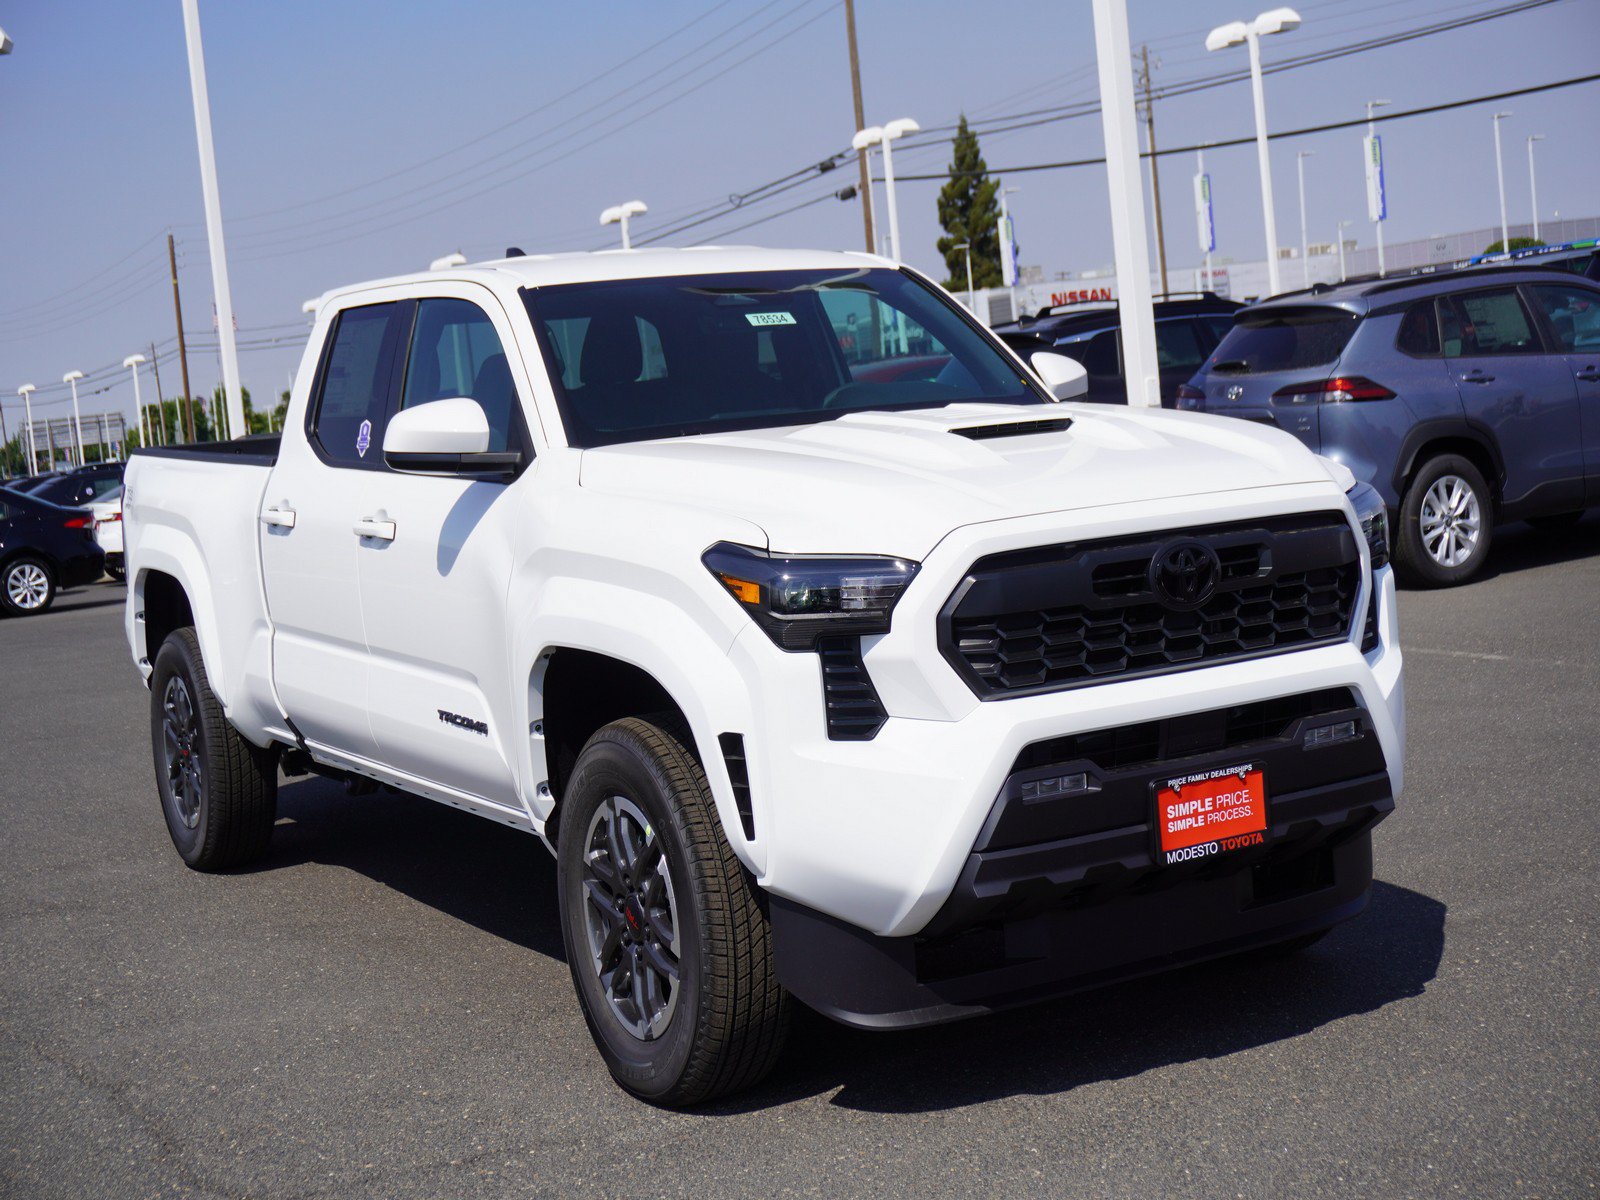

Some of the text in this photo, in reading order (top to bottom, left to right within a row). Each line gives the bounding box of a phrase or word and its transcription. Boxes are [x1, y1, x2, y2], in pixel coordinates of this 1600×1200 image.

[1051, 287, 1112, 307] NISSAN
[752, 314, 788, 324] 78534
[437, 709, 488, 737] TACOMA
[1167, 764, 1252, 788] PRICE FAMILY DEALERSHIPS
[1167, 790, 1253, 819] SIMPLE PRICE.
[1167, 806, 1253, 833] SIMPLE PROCESS.
[1166, 833, 1264, 864] MODESTO TOYOTA
